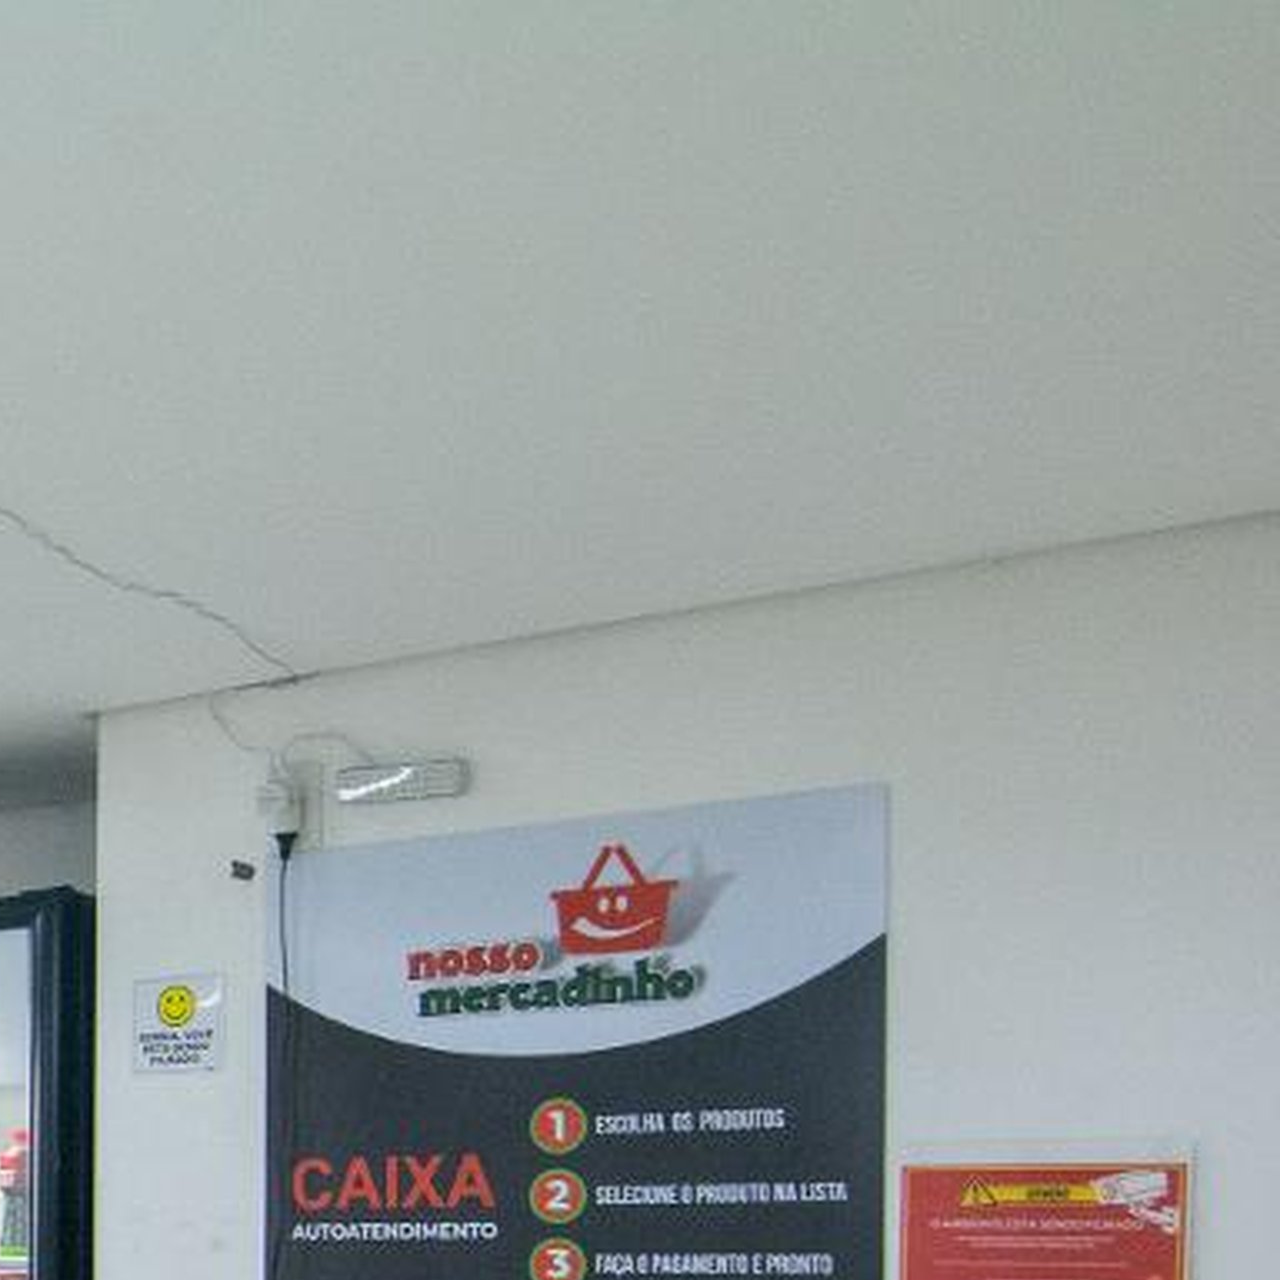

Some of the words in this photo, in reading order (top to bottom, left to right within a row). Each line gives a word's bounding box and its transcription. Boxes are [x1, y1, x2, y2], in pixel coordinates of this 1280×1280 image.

[407, 943, 539, 981] nosso
[417, 959, 694, 1017] mercadinho
[547, 1110, 564, 1140] 1
[595, 1114, 665, 1134] ESCOLHA
[671, 1112, 691, 1131] OS
[699, 1108, 785, 1130] PRODUTOS
[292, 1154, 495, 1212] CAIXA
[546, 1180, 570, 1210] 2
[595, 1186, 677, 1205] SELECIONE
[696, 1184, 769, 1204] PRODUTO
[774, 1184, 797, 1201] NA
[801, 1182, 848, 1201] LISTA
[292, 1221, 498, 1241] AUTOATENDIMENTO
[547, 1250, 570, 1279] 3
[595, 1253, 634, 1276] FAÇA
[652, 1254, 747, 1275] PAGAMENTO
[753, 1255, 762, 1274] E
[766, 1254, 833, 1276] PRONTO
